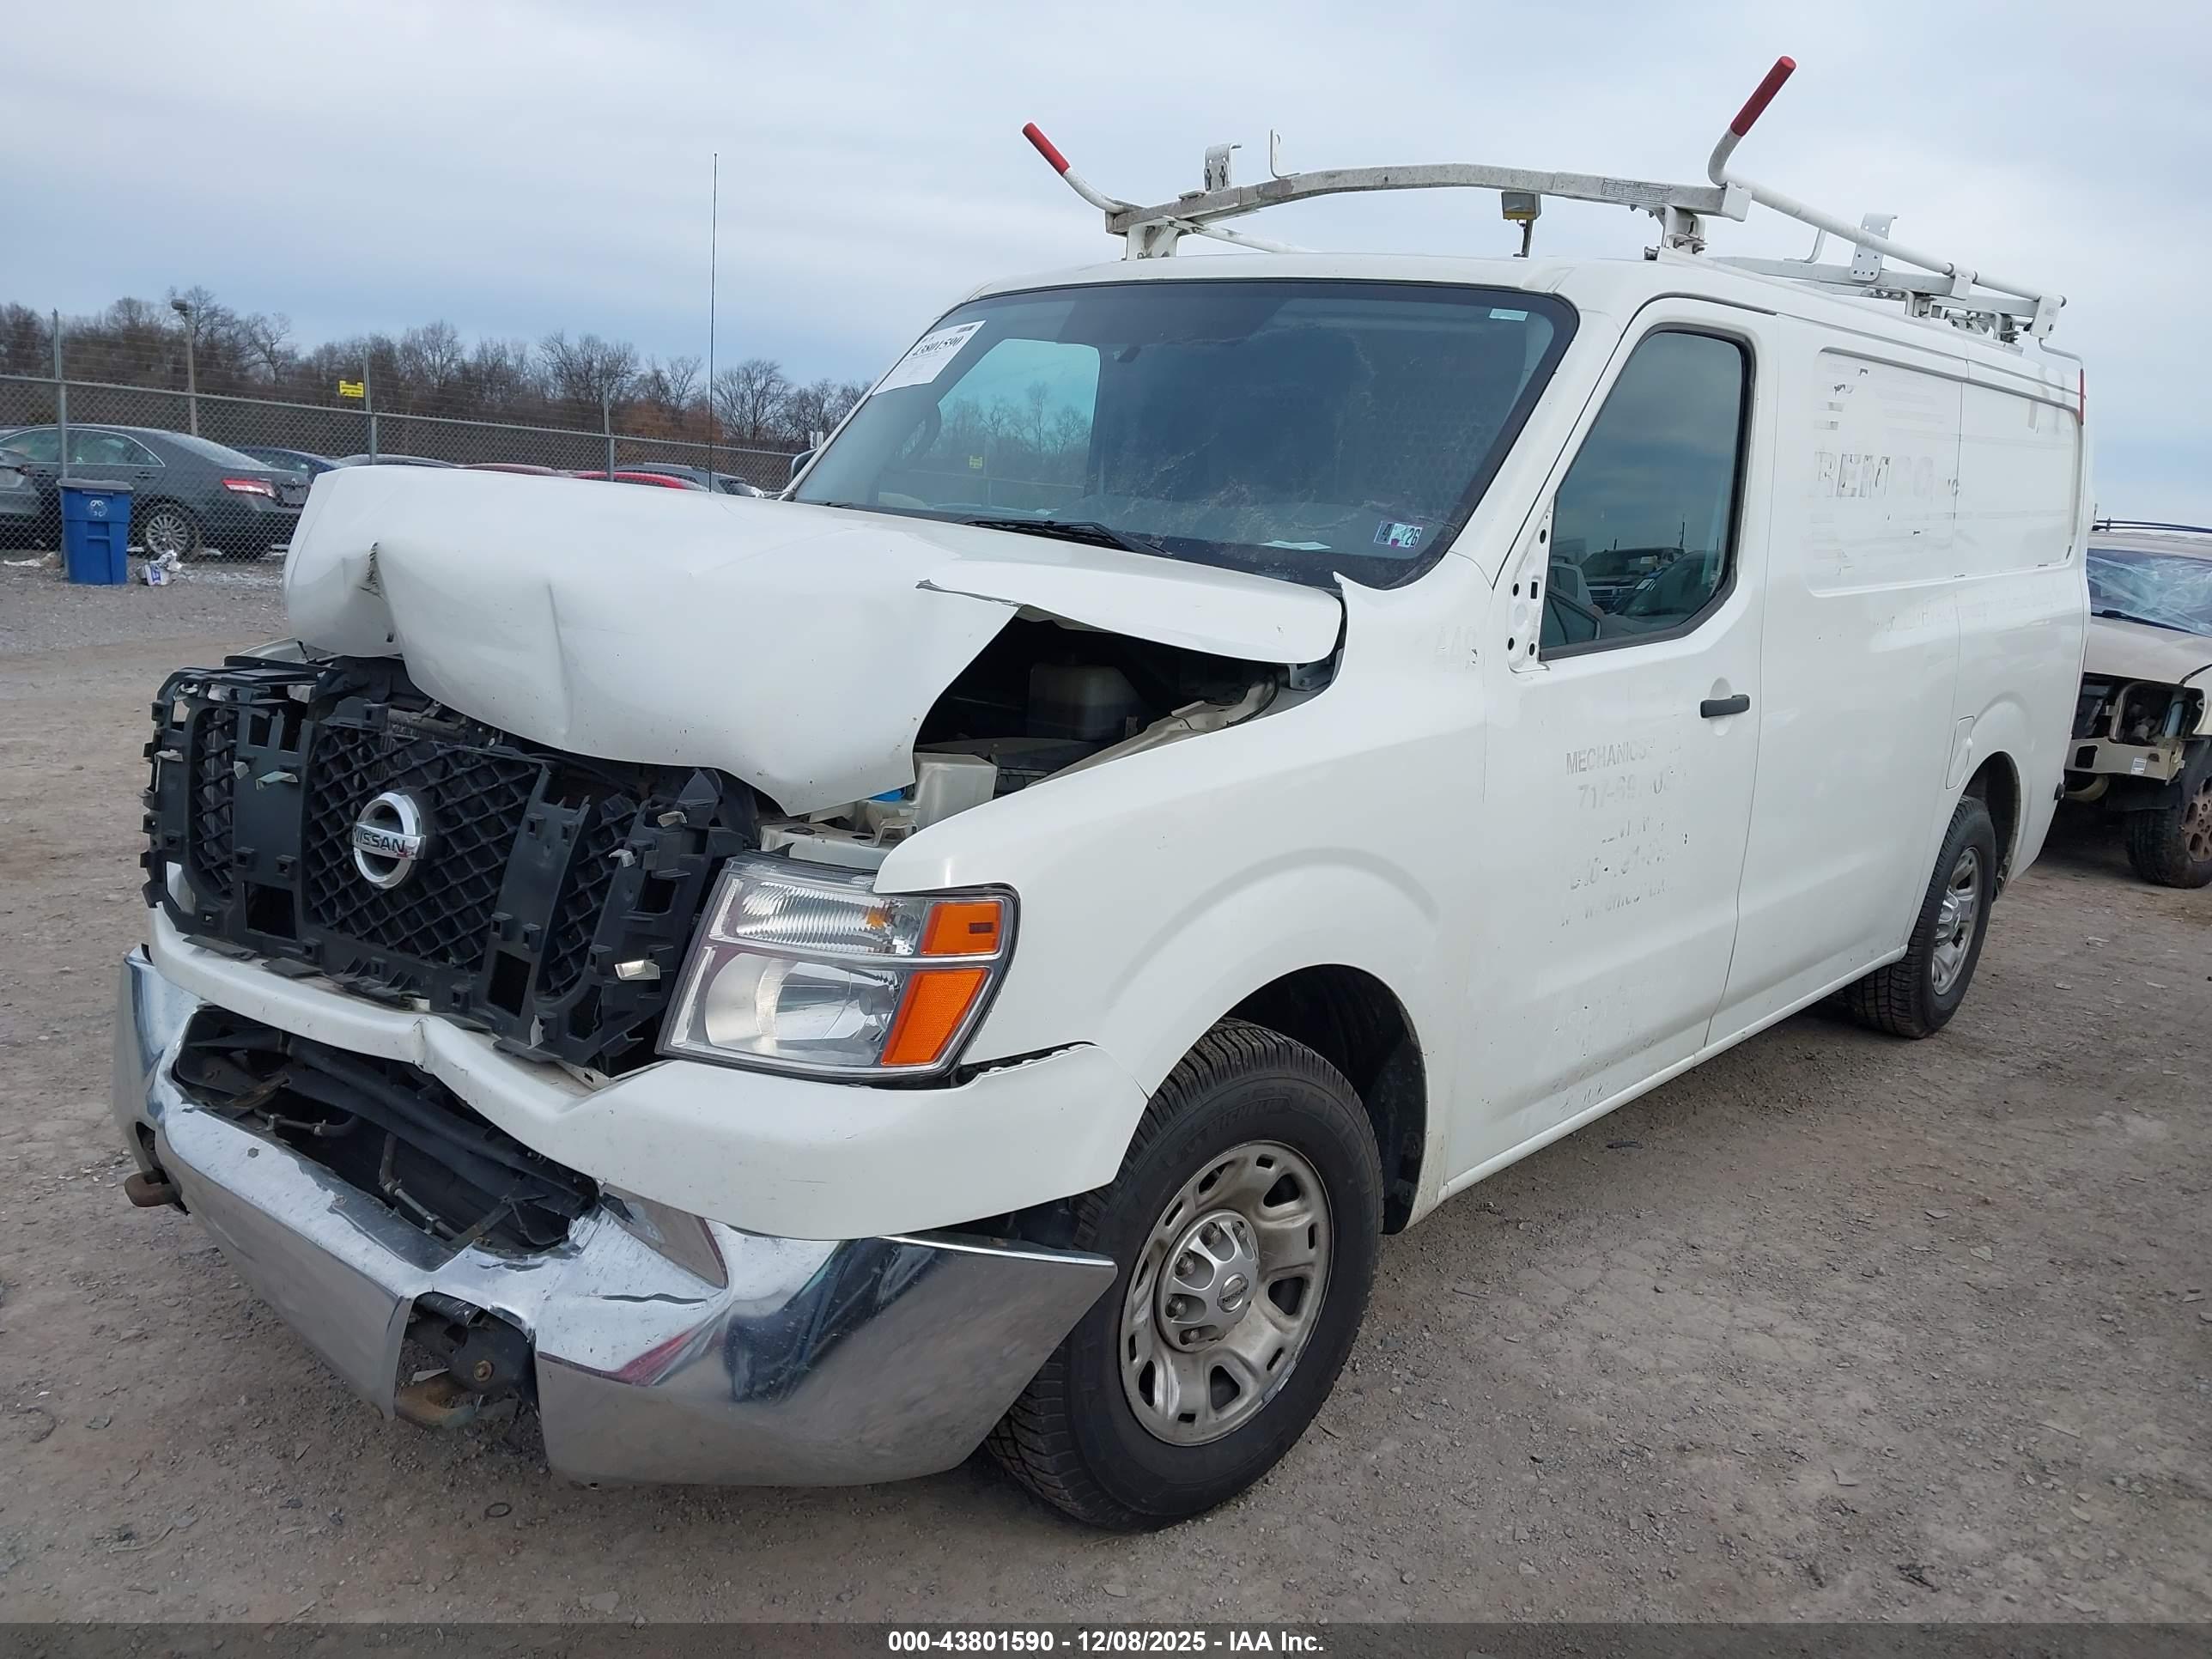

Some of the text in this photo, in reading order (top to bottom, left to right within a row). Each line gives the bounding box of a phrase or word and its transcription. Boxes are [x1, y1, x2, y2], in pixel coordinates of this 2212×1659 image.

[1382, 523, 1421, 546] 4 26
[353, 827, 406, 854] NISSAN
[1221, 1285, 1248, 1304] NISSAN
